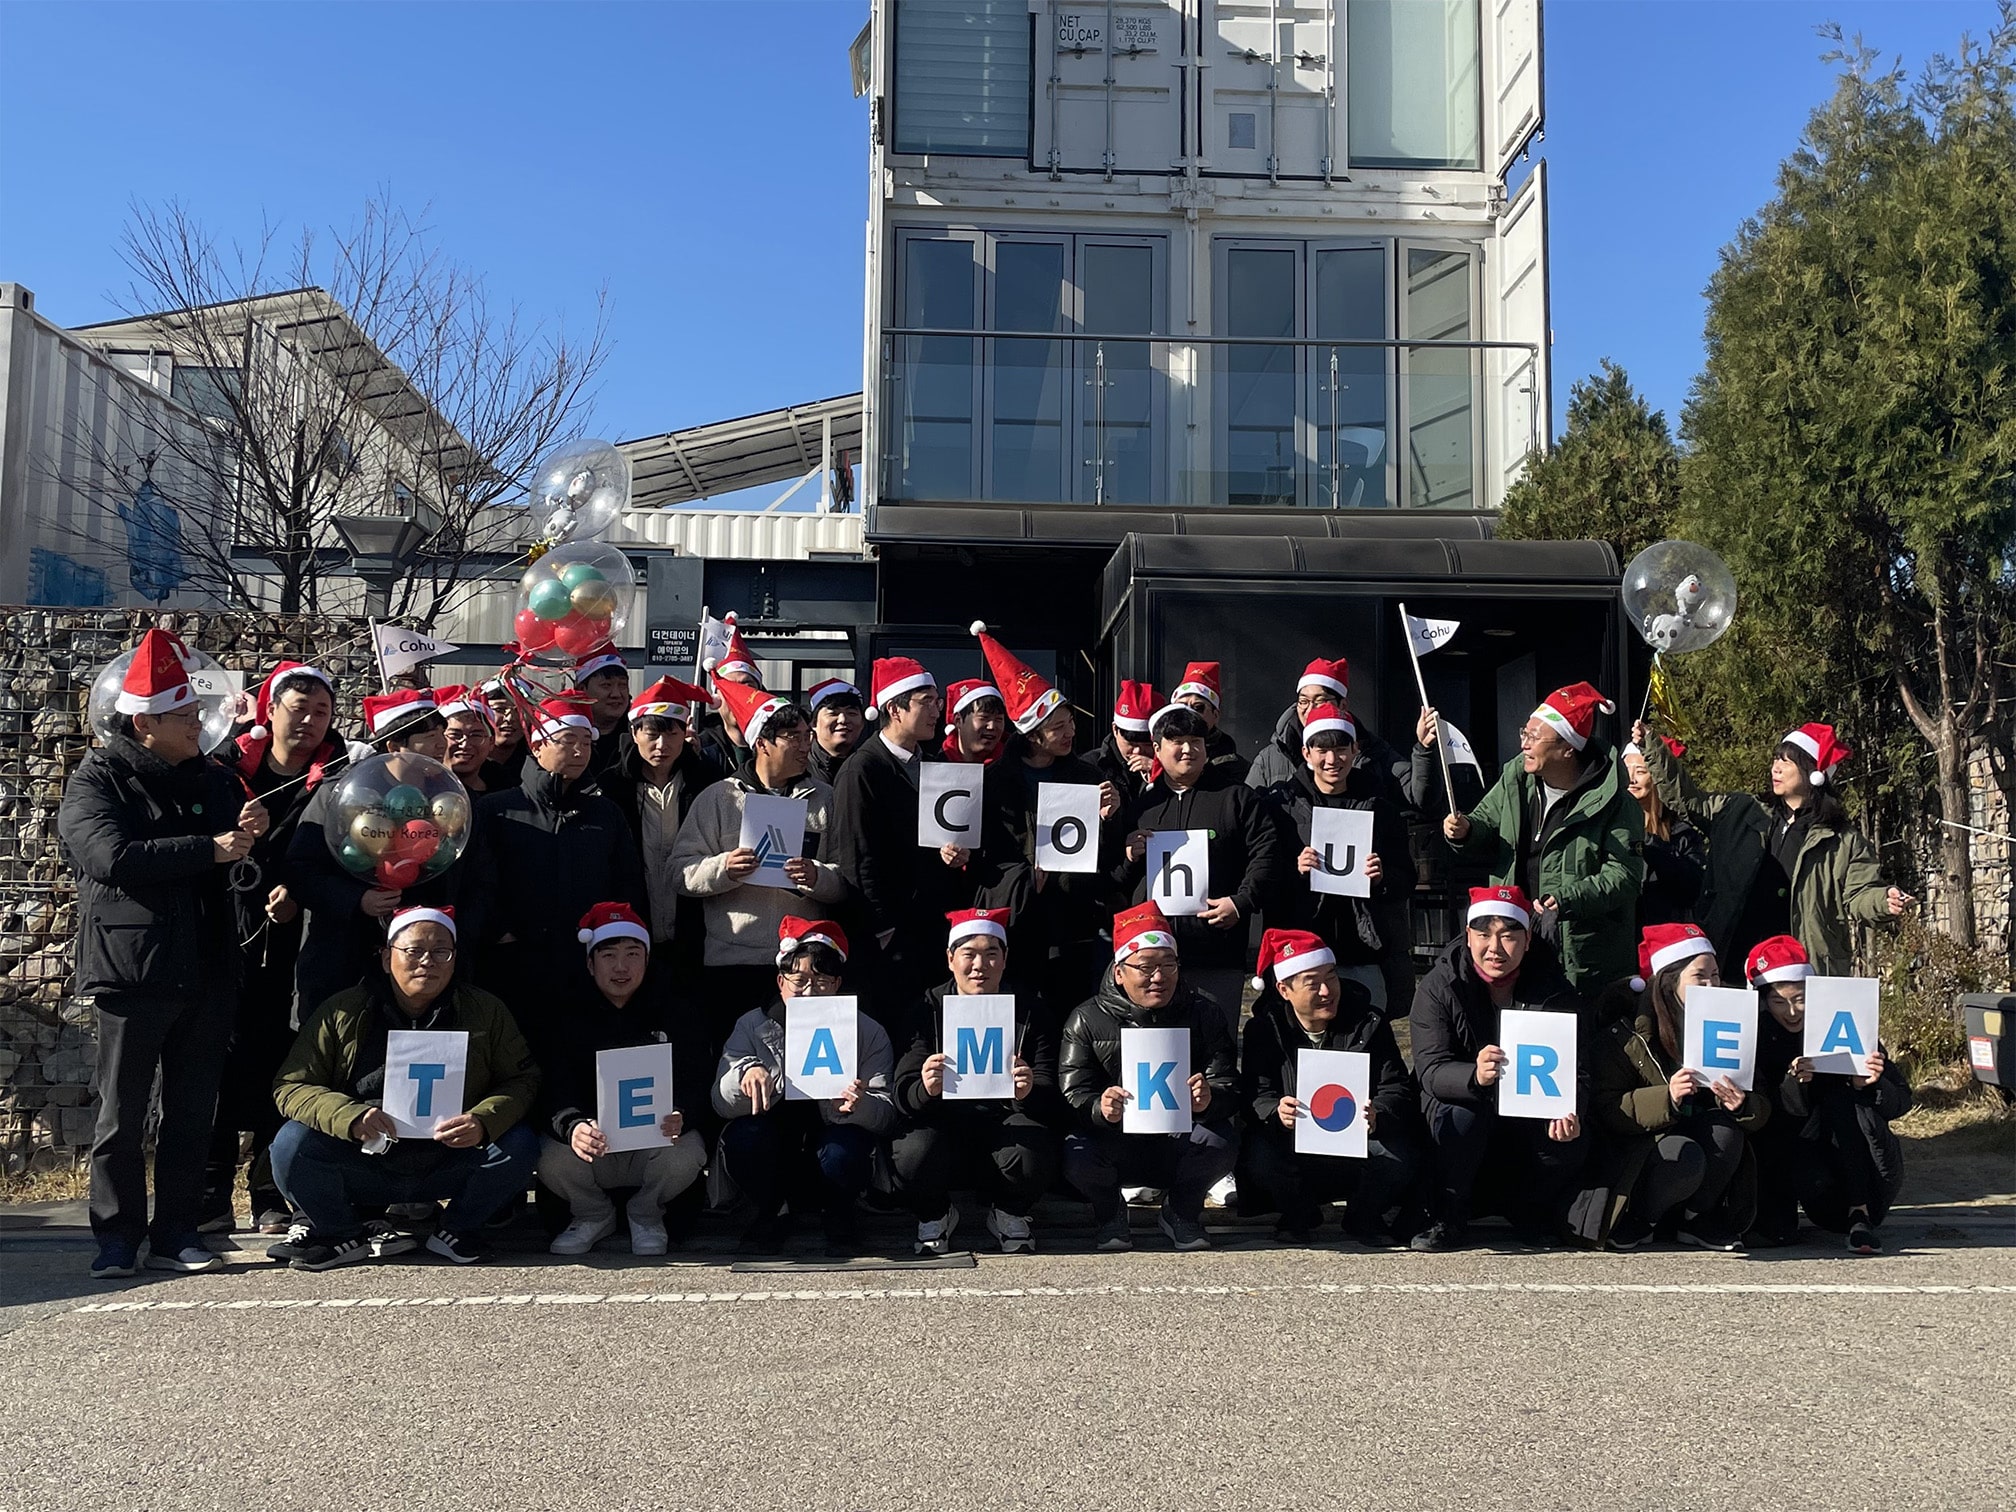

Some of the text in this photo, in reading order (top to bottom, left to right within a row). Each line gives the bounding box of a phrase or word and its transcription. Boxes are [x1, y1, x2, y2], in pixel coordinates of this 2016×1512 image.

[1060, 15, 1081, 28] NET
[1138, 17, 1152, 25] KGS
[399, 638, 436, 653] Cohu
[652, 630, 695, 641] 더컨테이너
[657, 646, 689, 655] 예약문의
[1421, 626, 1450, 640] Cohu
[360, 826, 439, 839] Cohu Korea
[934, 789, 971, 833] C
[1162, 850, 1194, 897] h
[801, 1027, 844, 1076] A
[956, 1027, 1003, 1075] M
[1702, 1019, 1742, 1070] E
[1820, 1011, 1864, 1055] A
[409, 1063, 445, 1116] T
[1137, 1061, 1178, 1111] K
[1516, 1044, 1561, 1097] R
[619, 1078, 654, 1127] E
